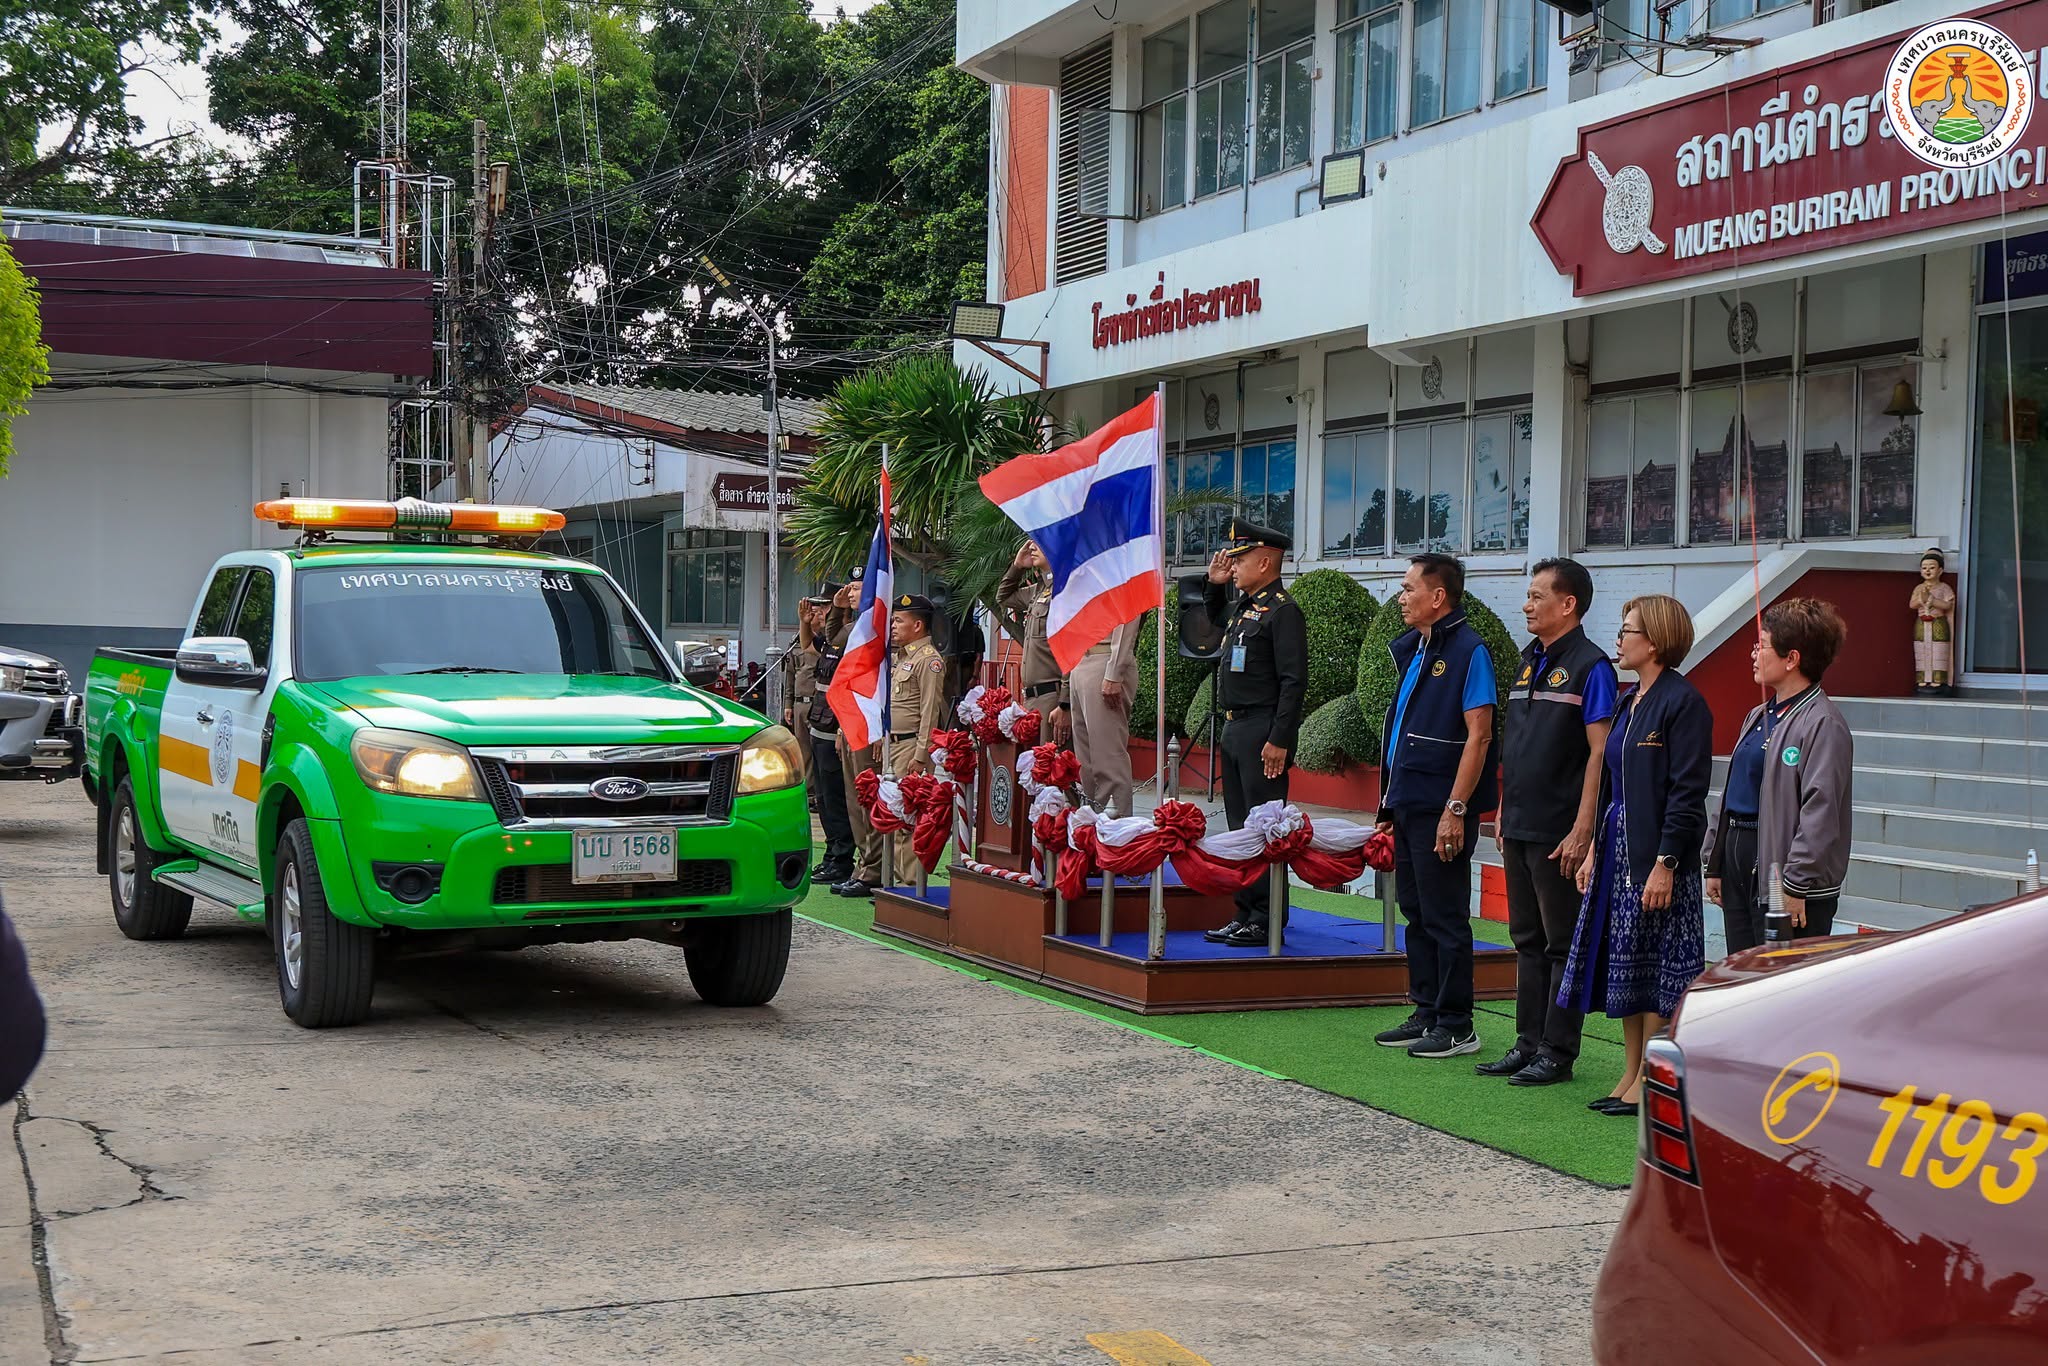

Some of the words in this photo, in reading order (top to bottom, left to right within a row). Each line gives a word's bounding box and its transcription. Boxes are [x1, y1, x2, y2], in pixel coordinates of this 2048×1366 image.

[1674, 208, 1767, 260] MUEANG
[1770, 180, 1892, 240] BURIRAM
[1900, 145, 2048, 213] PROVINCI
[339, 569, 574, 593] เทศบาลนครบุรีรัมย์
[604, 780, 637, 795] Ford
[622, 835, 671, 857] 1568
[1866, 1083, 2048, 1205] 1193
